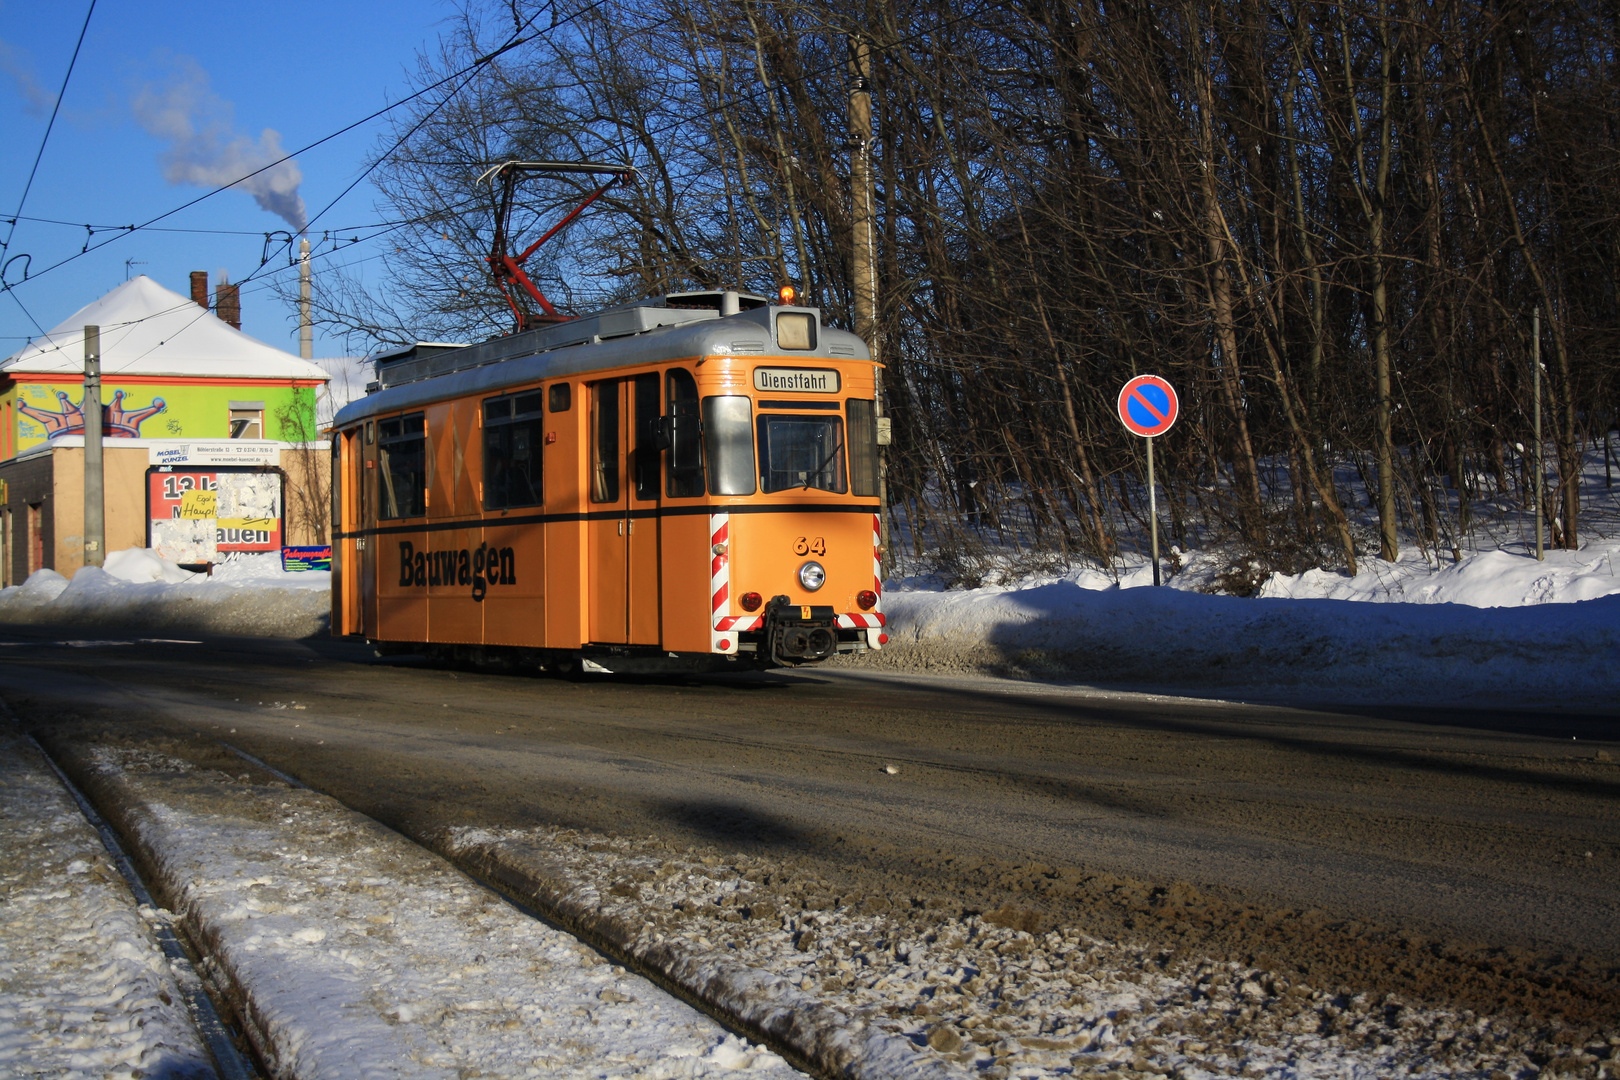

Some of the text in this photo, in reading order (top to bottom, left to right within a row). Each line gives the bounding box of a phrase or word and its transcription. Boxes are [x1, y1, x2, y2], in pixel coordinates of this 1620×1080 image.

[761, 371, 827, 389] Dienstfahrt
[163, 475, 196, 500] 13
[793, 537, 826, 556] 64
[399, 541, 516, 602] Bauwagen
